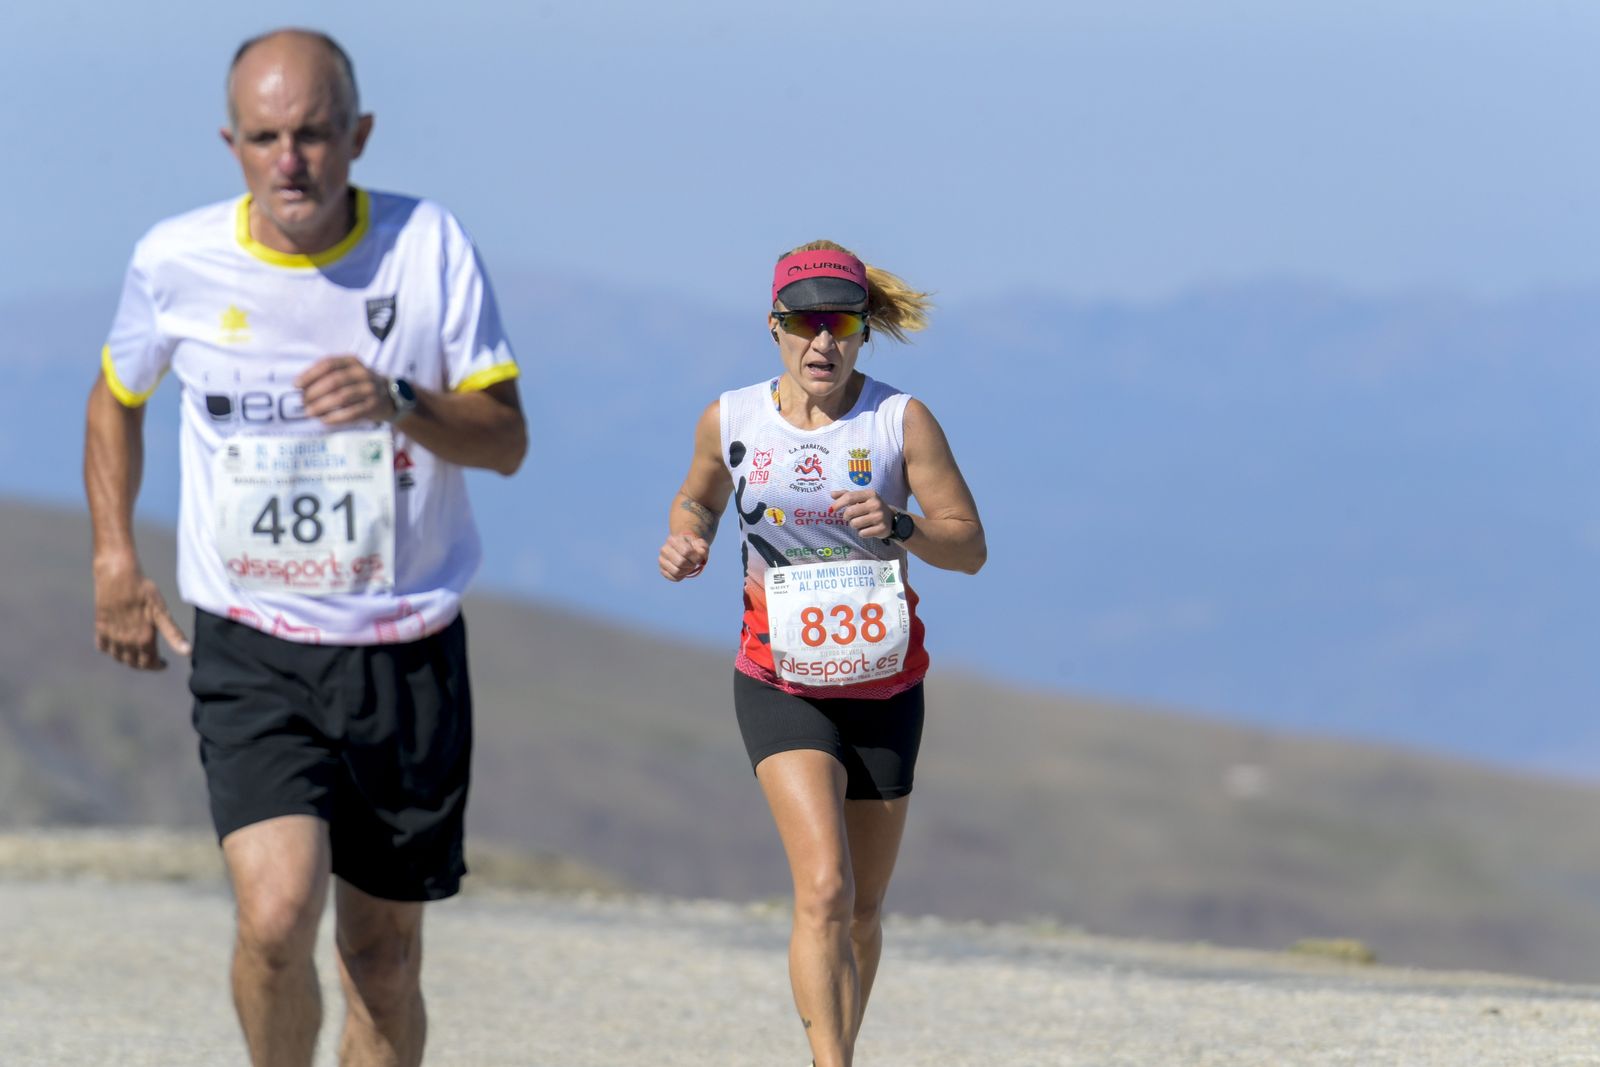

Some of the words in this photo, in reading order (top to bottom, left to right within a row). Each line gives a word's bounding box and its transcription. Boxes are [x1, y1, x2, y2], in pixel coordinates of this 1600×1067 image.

[804, 262, 857, 276] LURBEL
[800, 443, 830, 455] MARATHON
[749, 470, 769, 481] OTSO
[252, 490, 356, 545] 481
[785, 546, 852, 559] enercoop
[227, 552, 384, 582] alssport.es
[791, 570, 812, 582] XVIII
[816, 565, 874, 579] MINISUBIDA
[799, 581, 812, 592] AL
[814, 579, 838, 590] PICO
[841, 576, 876, 588] VELETA
[800, 602, 887, 647] 838
[779, 652, 899, 683] alssport.es
